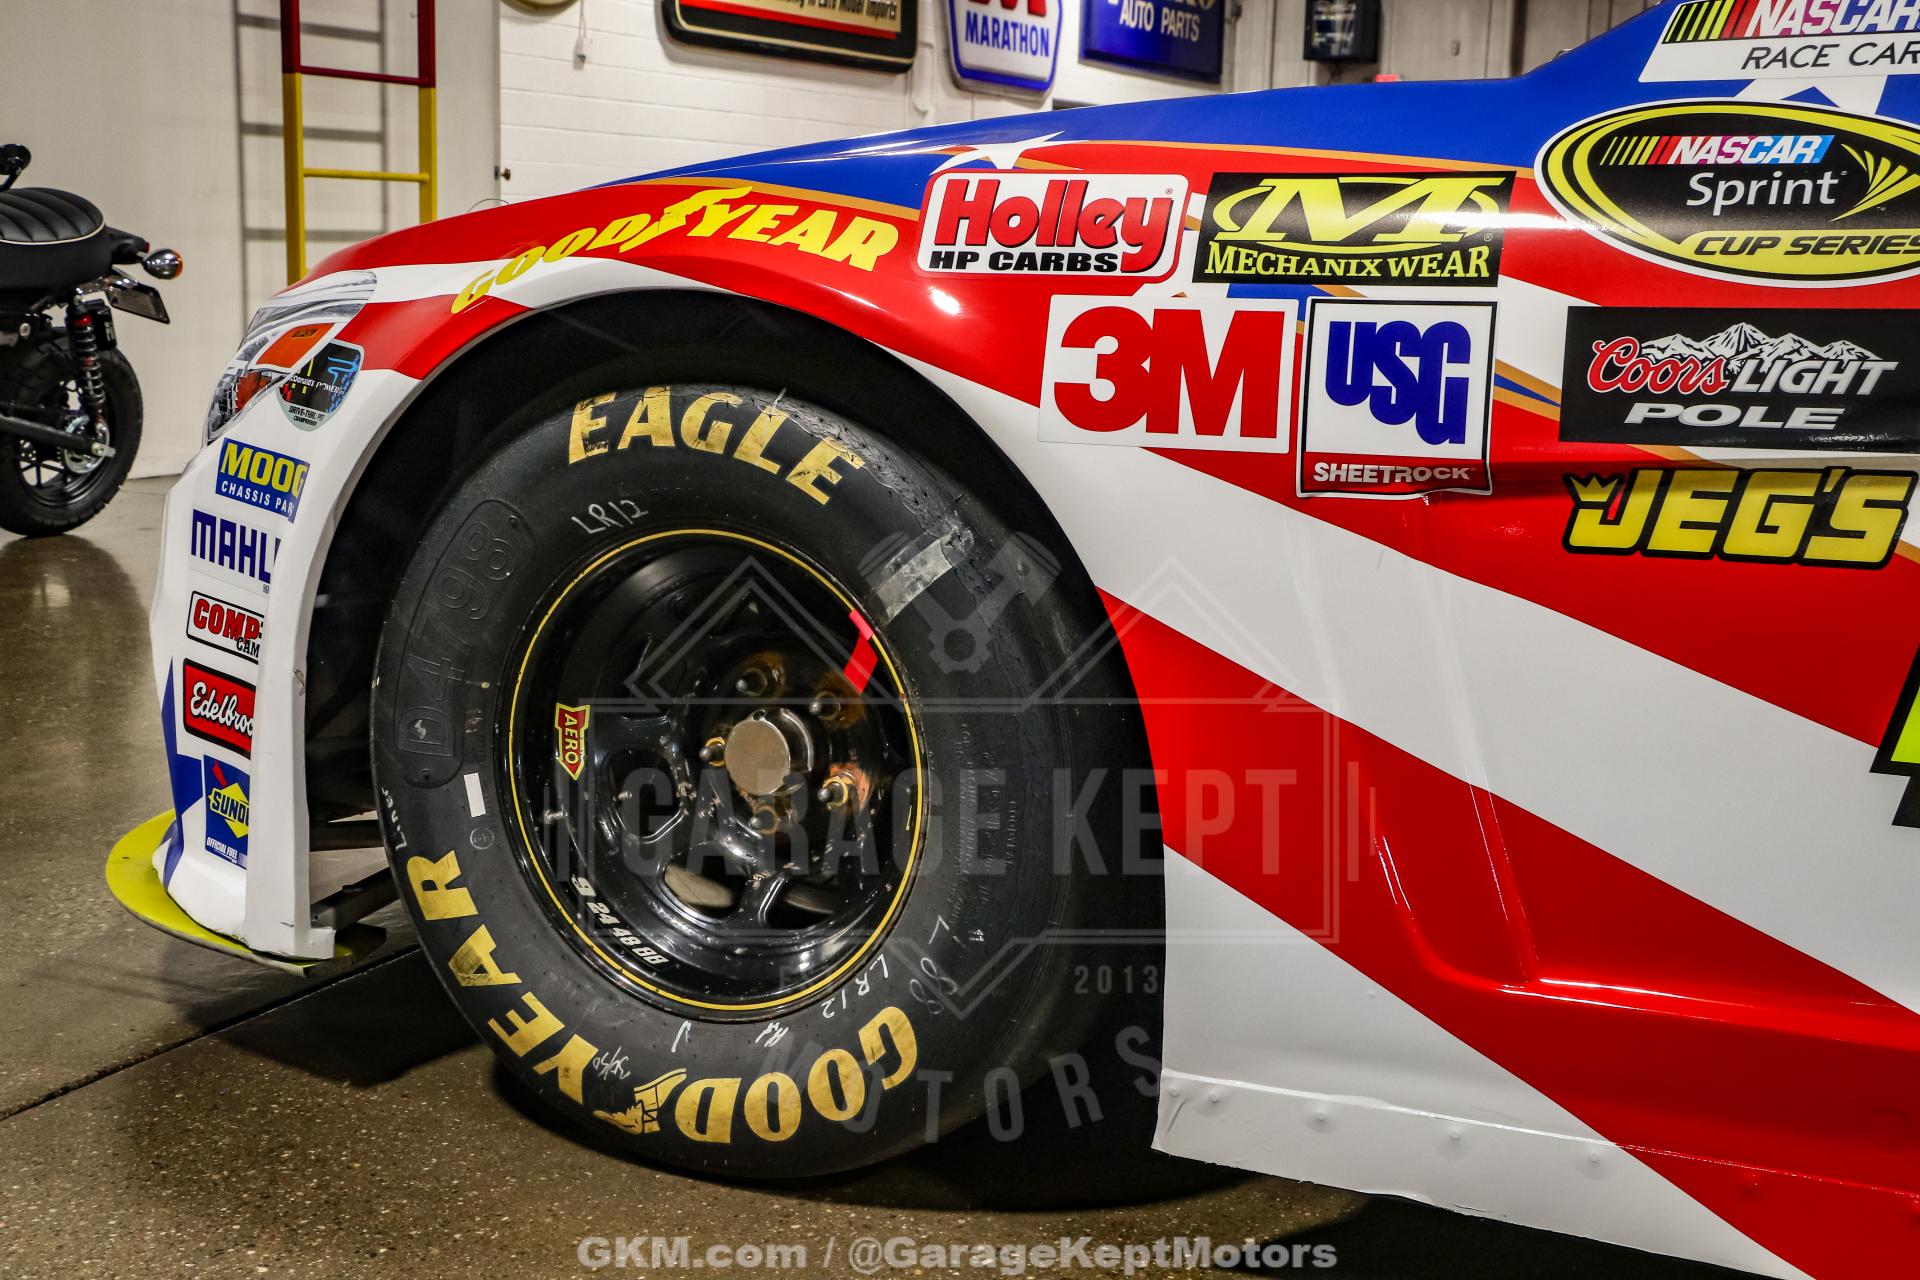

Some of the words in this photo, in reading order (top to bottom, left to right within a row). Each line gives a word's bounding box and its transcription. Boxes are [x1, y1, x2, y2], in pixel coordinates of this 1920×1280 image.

[964, 11, 1050, 57] MARATHON
[1119, 3, 1154, 31] AUTO
[1160, 8, 1201, 42] PARTS
[1741, 44, 1840, 70] RACE
[1668, 137, 1822, 164] NASCAR
[1686, 171, 1840, 216] Sprint
[933, 178, 1174, 274] Holley
[1694, 236, 1763, 256] CUP
[450, 186, 899, 314] GOODYEAR
[929, 251, 980, 270] HP
[988, 253, 1118, 273] CARBS
[1204, 241, 1383, 277] MECHANIX
[1387, 245, 1491, 278] WEAR
[1053, 306, 1285, 438] 3M
[1325, 320, 1471, 445] USG
[1587, 336, 1731, 396] Coors
[1730, 360, 1899, 395] LIGHT
[1624, 403, 1845, 430] POLE
[569, 385, 866, 505] EAGLE
[220, 442, 308, 498] MOOG
[1313, 462, 1471, 484] SHEETROCK
[221, 481, 271, 506] CHASSIS
[1564, 467, 1917, 570] JEG'S
[190, 509, 282, 584] MAHL
[193, 599, 261, 642] COMP
[563, 712, 579, 765] AERO
[571, 874, 596, 896] 9
[586, 902, 620, 924] 24
[612, 928, 642, 946] 48
[632, 947, 669, 964] 88
